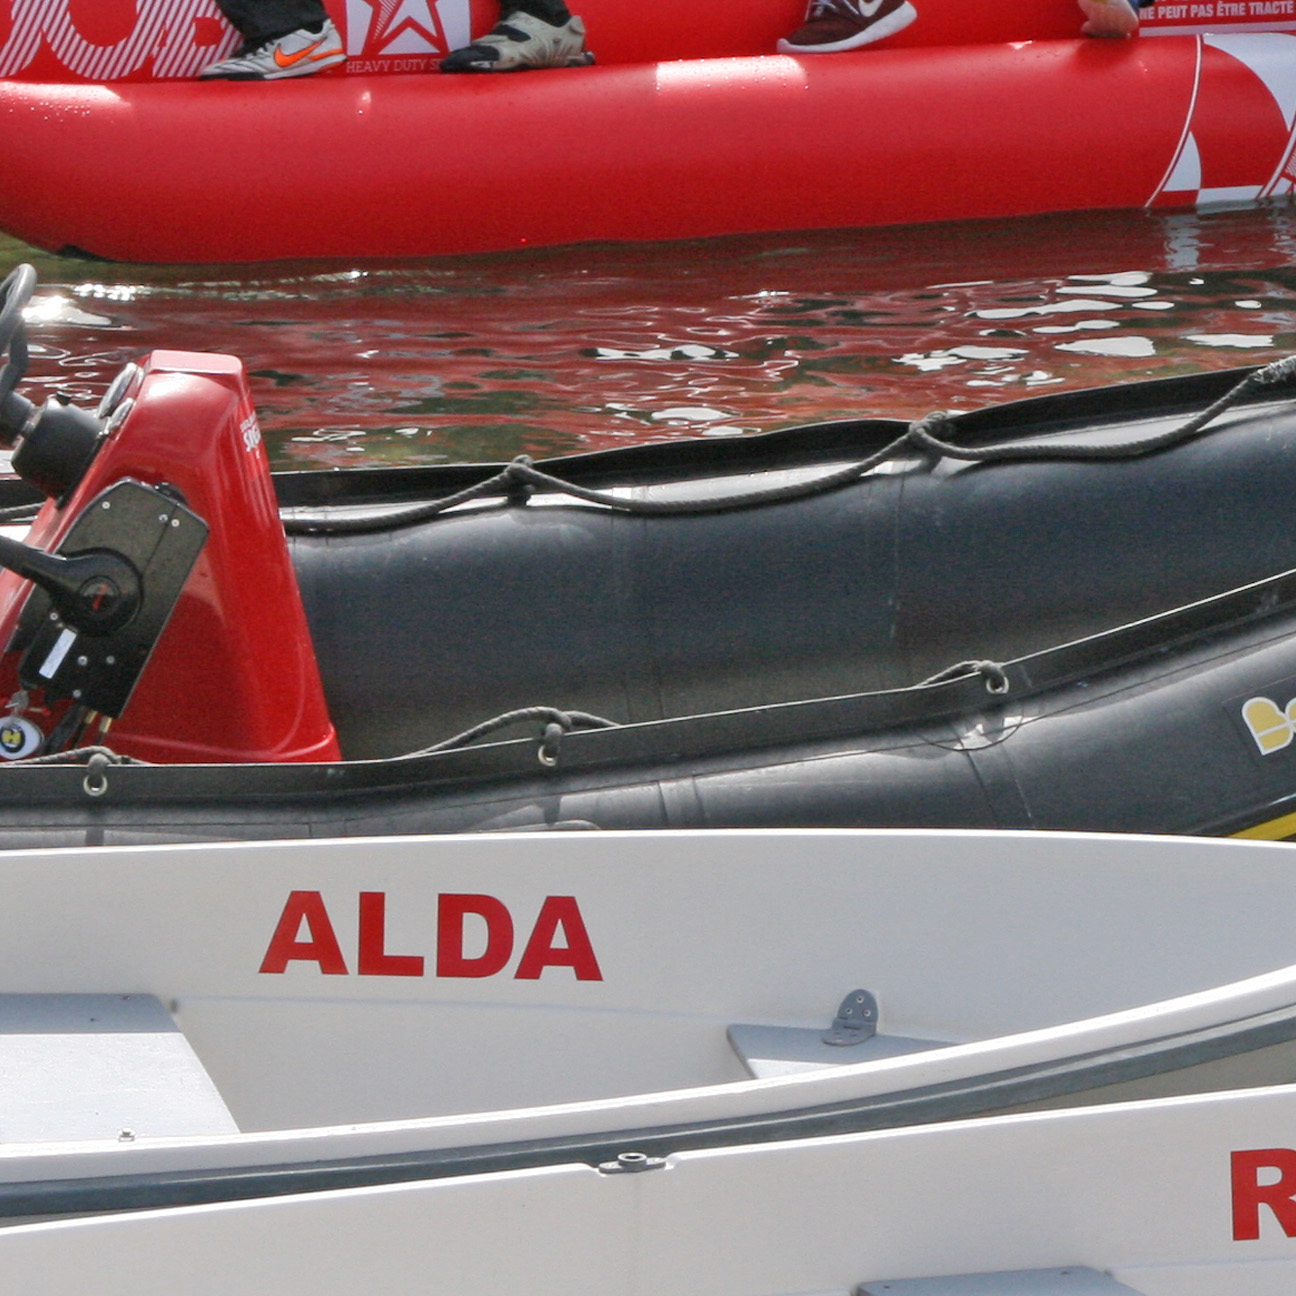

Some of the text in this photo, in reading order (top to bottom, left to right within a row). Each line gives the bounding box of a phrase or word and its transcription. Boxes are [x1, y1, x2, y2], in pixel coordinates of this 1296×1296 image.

[1158, 5, 1189, 19] PEUT
[1190, 4, 1213, 17] PAS
[1216, 1, 1247, 16] ÊTRE
[346, 60, 392, 73] HEAVY
[393, 58, 426, 72] DUTY
[259, 890, 604, 982] ALDA
